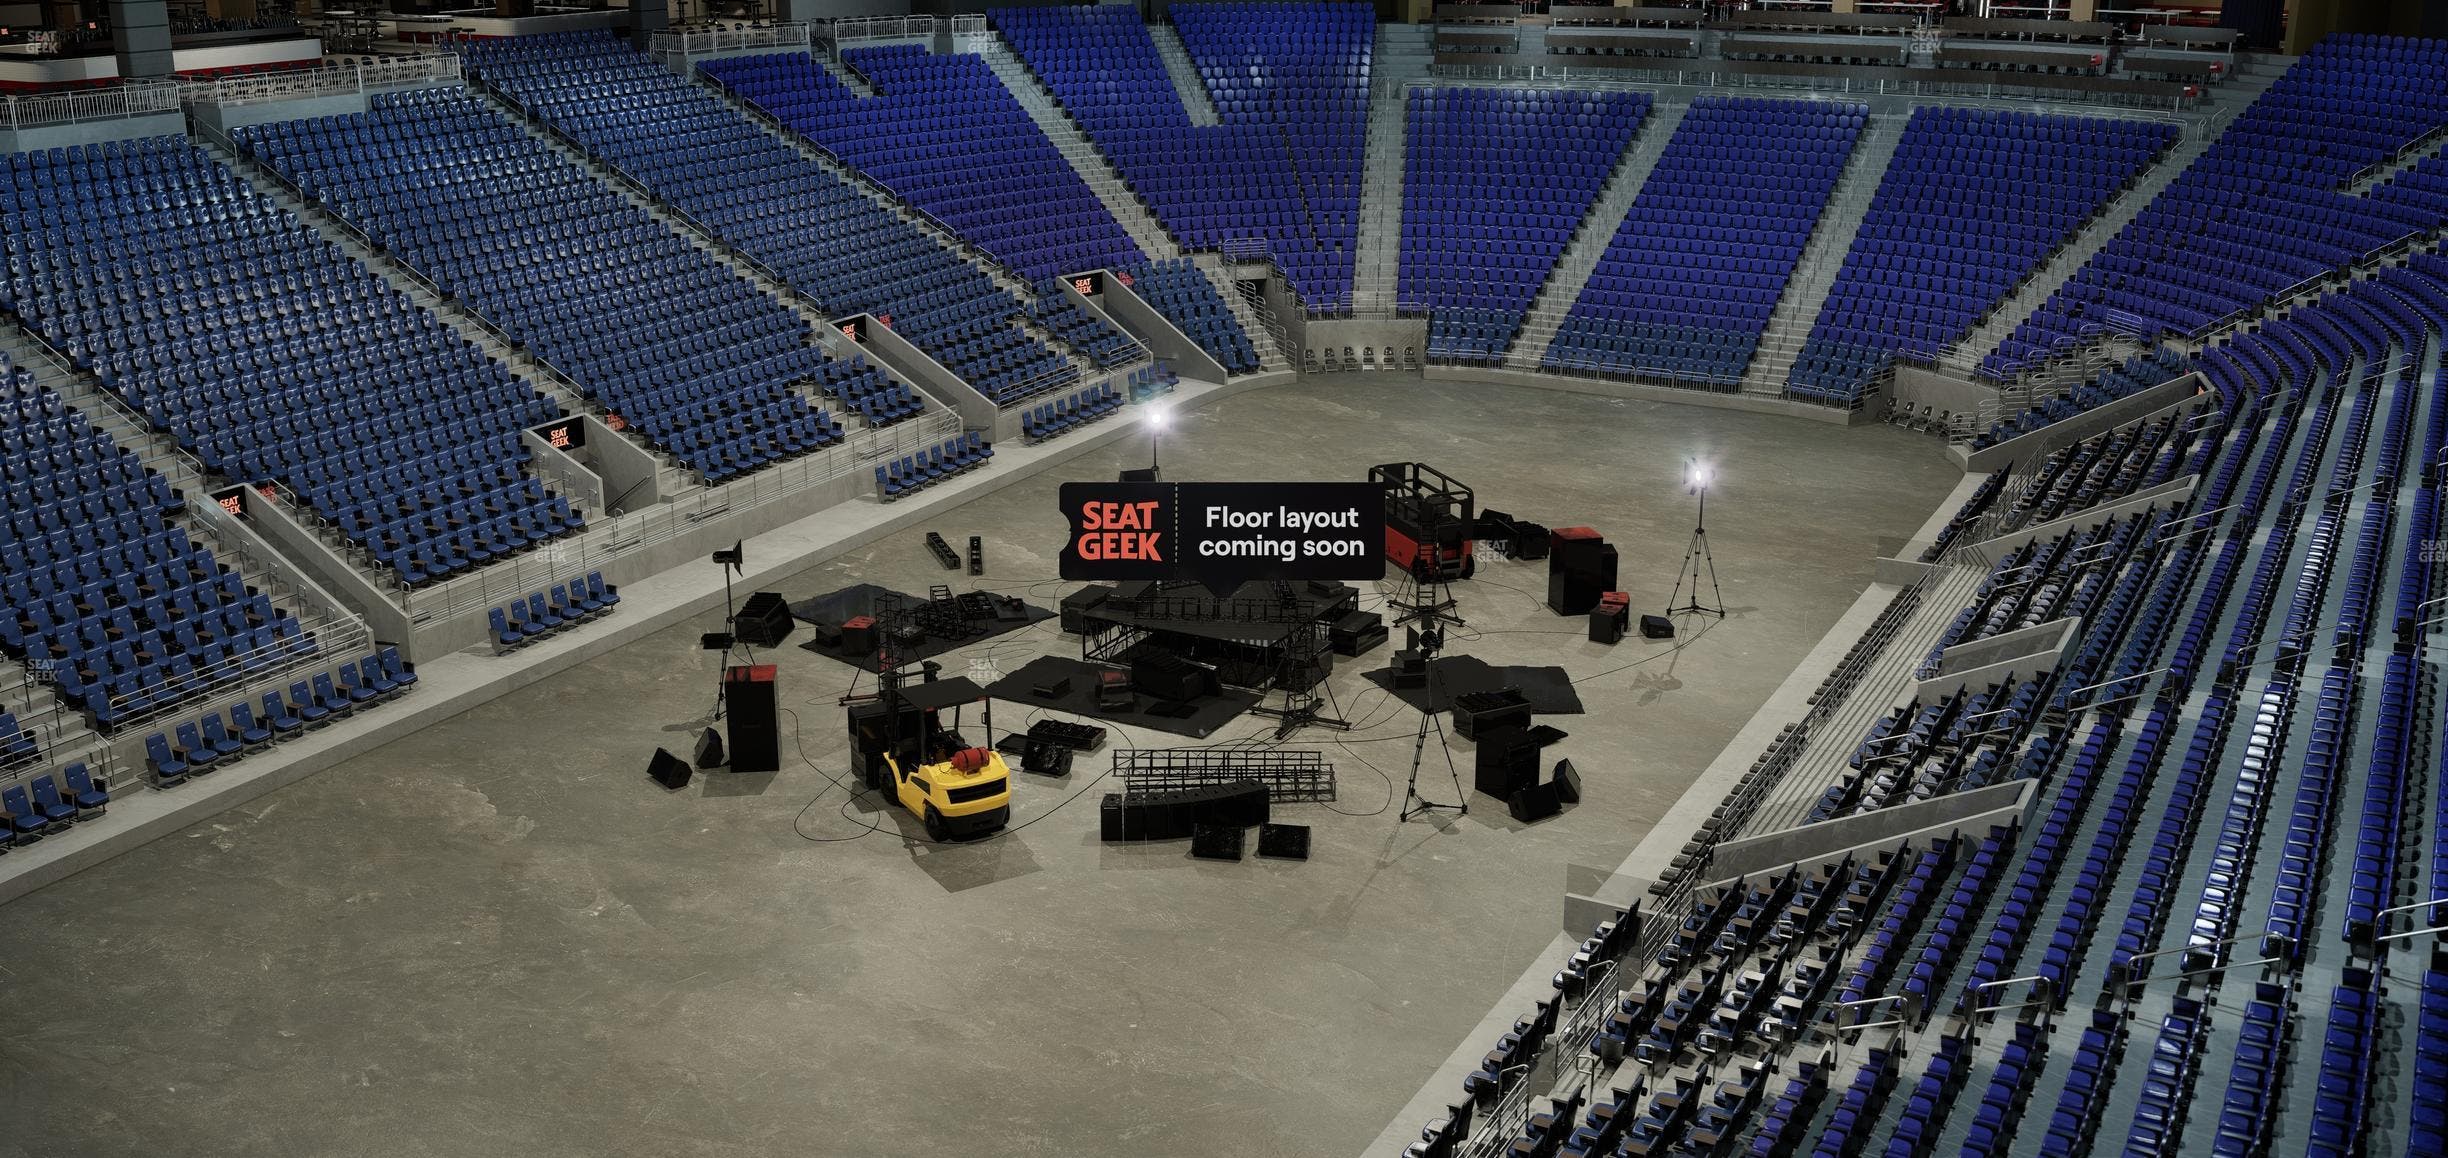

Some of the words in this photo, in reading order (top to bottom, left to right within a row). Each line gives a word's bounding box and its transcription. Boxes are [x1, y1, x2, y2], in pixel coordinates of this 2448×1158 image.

[1075, 278, 1091, 288] SEAT
[551, 426, 567, 439] SEAT
[551, 436, 569, 448] GEEK
[220, 495, 239, 508] SEAT
